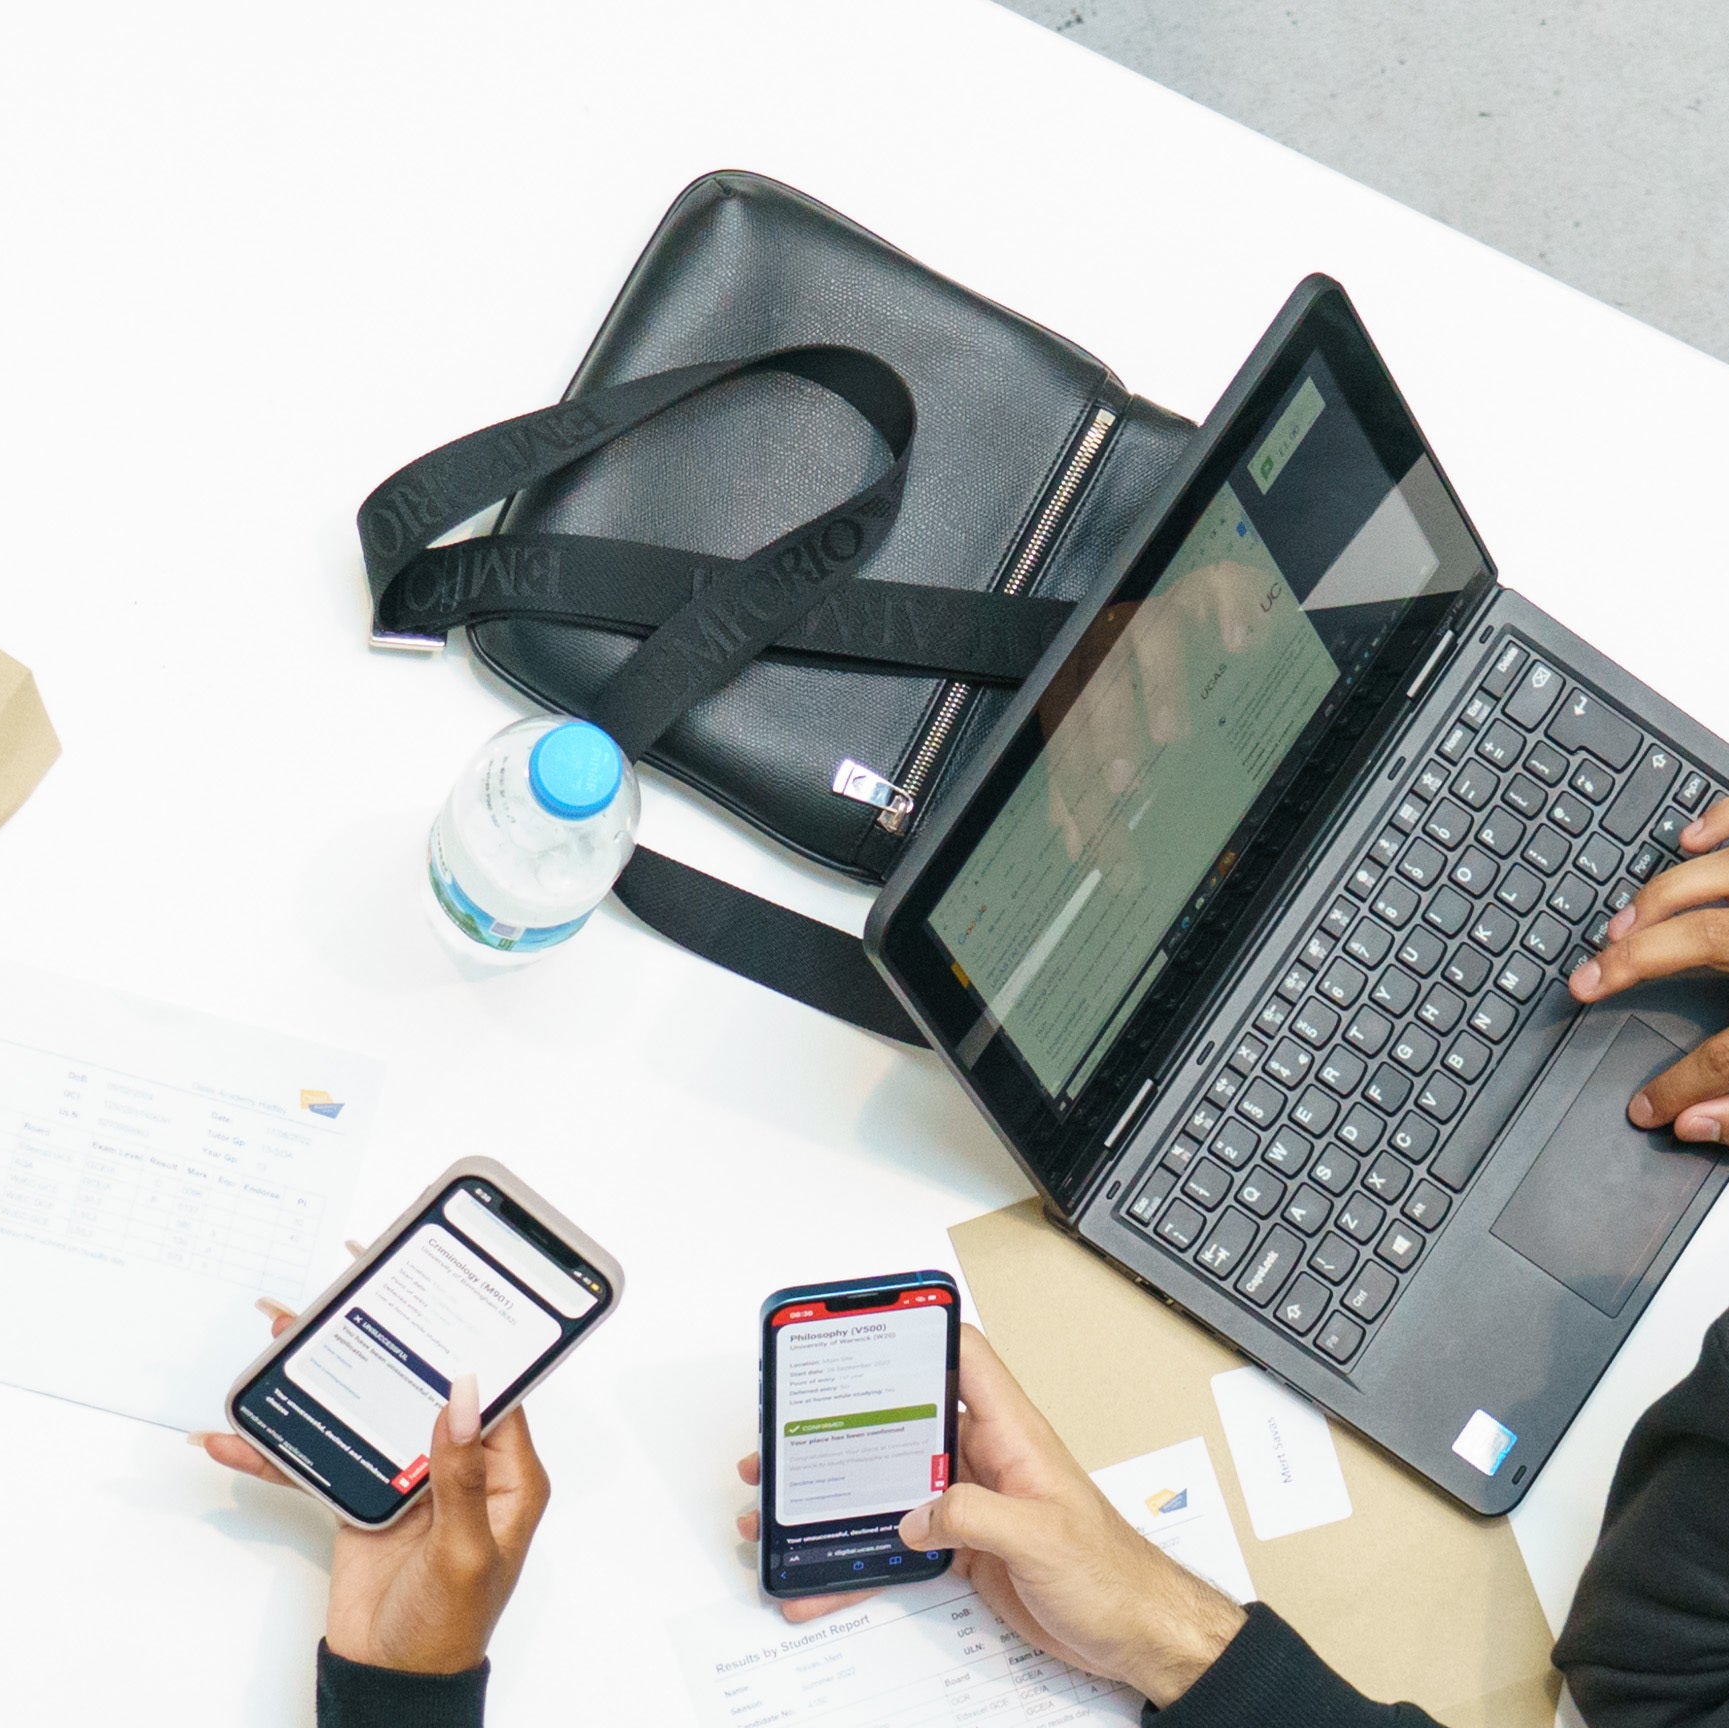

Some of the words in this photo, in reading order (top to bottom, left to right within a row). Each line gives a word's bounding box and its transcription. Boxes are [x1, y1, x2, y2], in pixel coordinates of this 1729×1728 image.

[650, 514, 866, 706] EMPORIO
[1496, 644, 1521, 674] Delete
[1614, 890, 1631, 909] Ctrl
[1410, 1201, 1427, 1218] Alt
[420, 1245, 453, 1274] University
[459, 1277, 498, 1312] Birmingham
[427, 1236, 481, 1284] Criminology
[479, 1280, 514, 1311] (M901)
[1245, 1249, 1281, 1294] CapsLock
[1351, 1288, 1369, 1308] Ctrl
[361, 1321, 409, 1362] UNSUCCESSFUL
[790, 1328, 848, 1344] Philosophy
[850, 1322, 886, 1335] (V500)
[332, 1332, 369, 1363] application
[790, 1341, 827, 1352] University
[839, 1335, 870, 1345] Warwick
[341, 1325, 355, 1338] You
[353, 1335, 371, 1350] have
[369, 1347, 388, 1364] been
[385, 1361, 430, 1397] unsuccessful
[802, 1420, 844, 1431] CONFIRMED
[273, 1387, 289, 1401] Your
[285, 1398, 327, 1433] unsuccessful,
[324, 1429, 351, 1452] declined
[358, 1457, 391, 1484] withdrawn
[809, 1436, 829, 1445] place
[846, 1431, 864, 1439] been
[866, 1426, 905, 1436] confirmed
[1275, 1452, 1293, 1484] Mert
[803, 1530, 849, 1543] unsuccessful,
[850, 1526, 878, 1535] declined
[834, 1542, 892, 1557] digital.ucas.com
[951, 1607, 972, 1621] DoB:
[957, 1625, 976, 1639] UCI:
[715, 1650, 761, 1675] Results
[762, 1644, 779, 1661] by
[780, 1627, 828, 1653] Student
[828, 1613, 871, 1637] Report
[963, 1641, 985, 1656] ULN:
[1007, 1650, 1032, 1666] Exam
[943, 1671, 971, 1688] Board
[1014, 1668, 1043, 1685] GCE/A
[950, 1693, 971, 1707] OCR
[1019, 1684, 1049, 1701] GCE/A
[955, 1705, 988, 1723] Edexcel
[989, 1697, 1009, 1711] GCE
[1025, 1699, 1055, 1716] GCE/A
[1047, 1714, 1074, 1728] results
